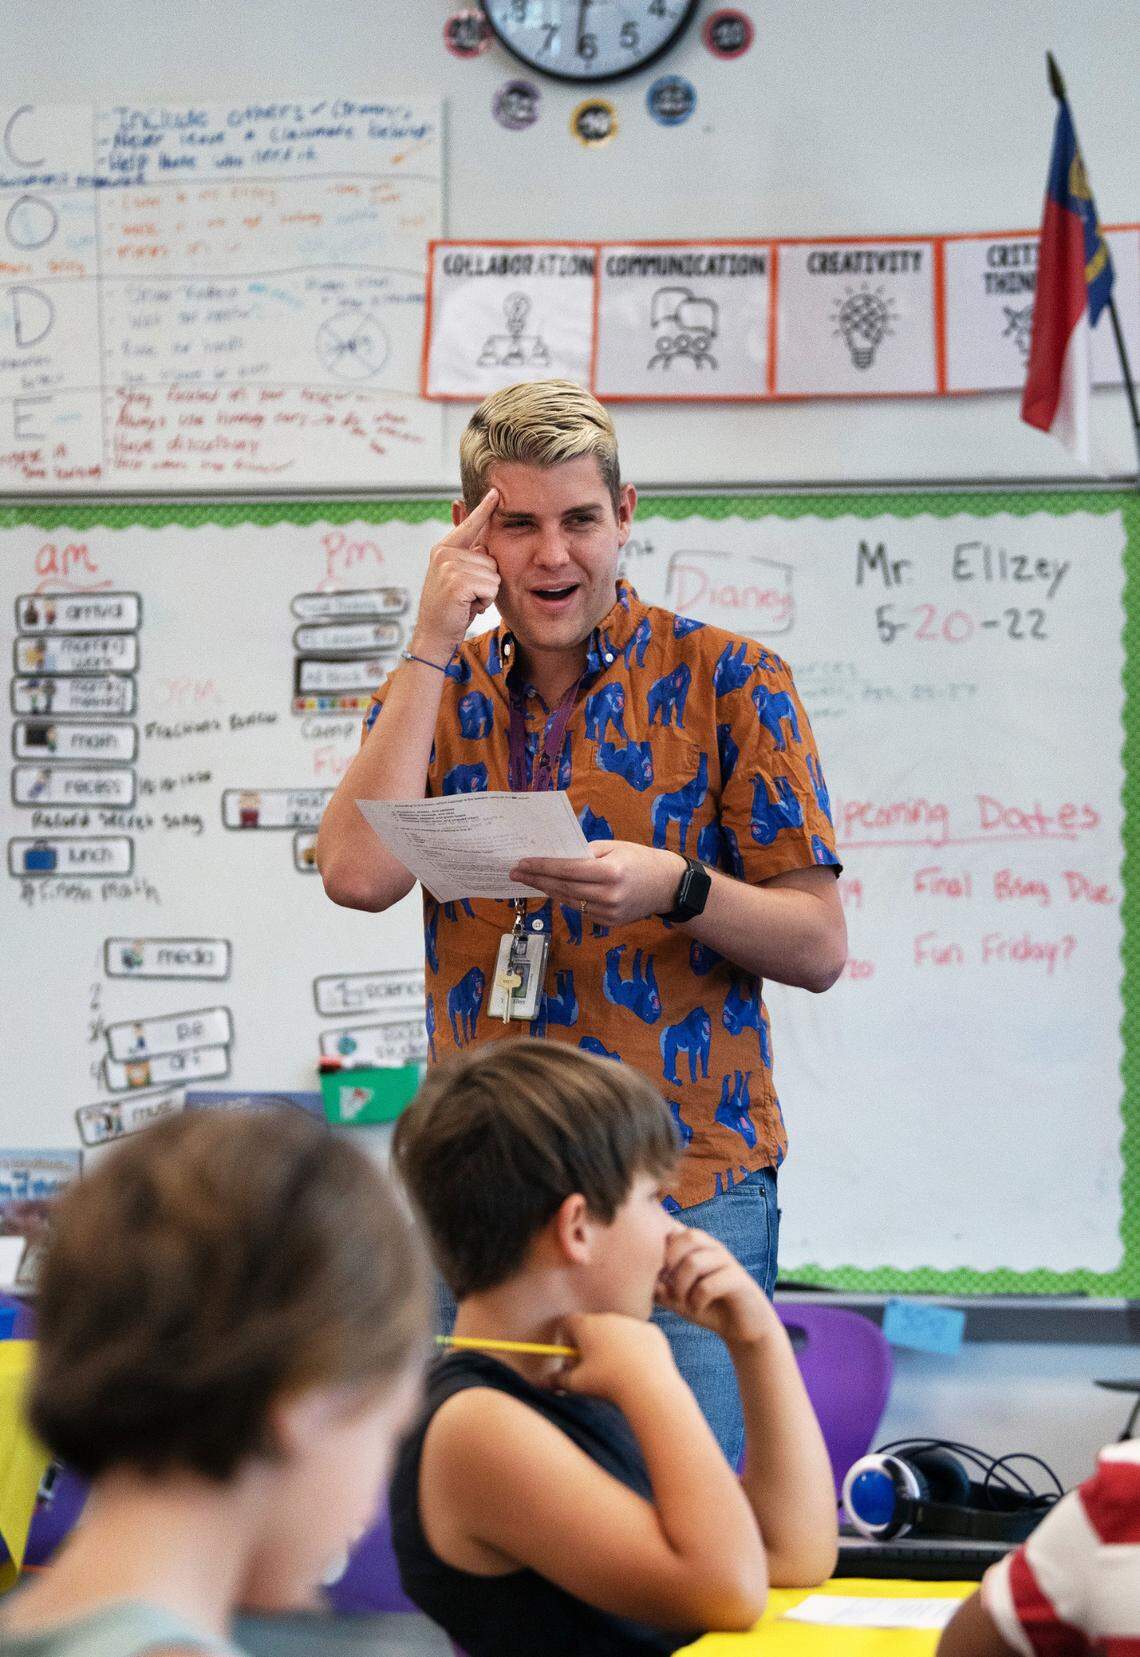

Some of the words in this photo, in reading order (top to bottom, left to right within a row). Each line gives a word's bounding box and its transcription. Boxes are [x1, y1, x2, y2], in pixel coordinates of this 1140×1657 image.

[540, 23, 559, 58] 7
[578, 32, 598, 60] 6
[620, 21, 639, 49] 5
[3, 104, 46, 169] C
[5, 194, 58, 251] O
[443, 255, 594, 276] COLLABORATION
[606, 256, 766, 277] COMMUNICATION
[806, 250, 922, 275] CREATIVITY
[986, 244, 1040, 268] CRIT
[8, 285, 56, 347] D
[14, 396, 53, 441] E
[34, 543, 97, 576] am
[951, 541, 1071, 600] Ellzey
[65, 603, 123, 619] arrival
[977, 794, 1099, 832] Dates
[68, 847, 113, 864] lunch
[913, 931, 964, 967] Fun
